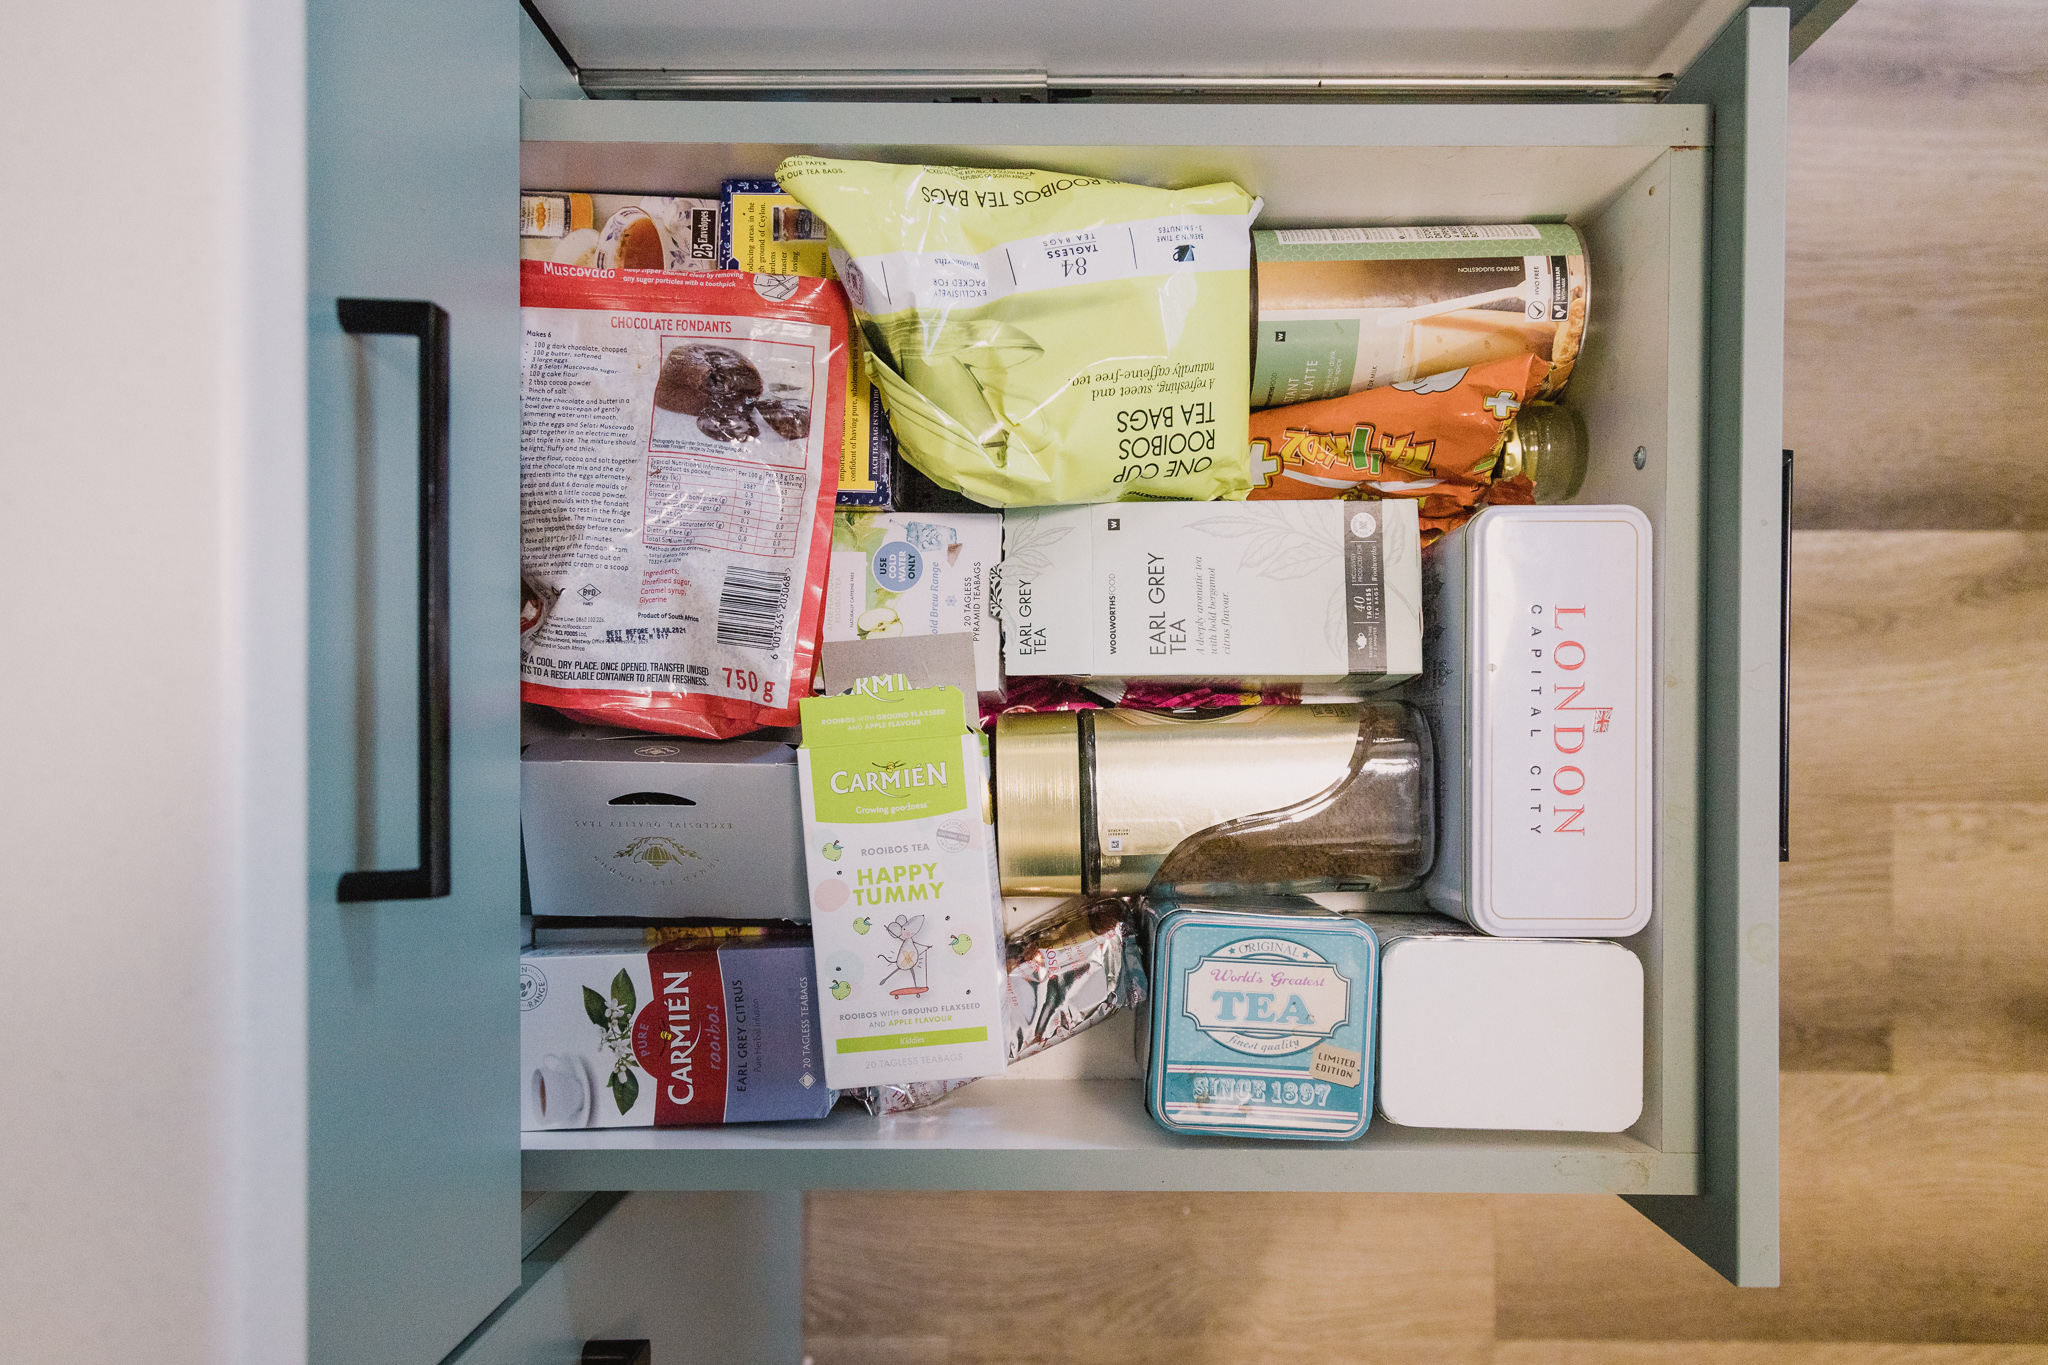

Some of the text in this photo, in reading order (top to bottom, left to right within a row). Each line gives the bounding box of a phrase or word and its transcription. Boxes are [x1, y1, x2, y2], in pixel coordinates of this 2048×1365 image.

[786, 169, 803, 180] OUR
[921, 176, 1102, 208] ROOIBOS TEA BAGS
[692, 210, 714, 258] 25 Envelopes
[747, 202, 755, 242] areas the
[758, 202, 767, 264] ground of Ceylon.
[1042, 232, 1096, 248] TEA BAGS
[1046, 243, 1099, 259] TAGLESS
[543, 261, 616, 279] Muscovado
[791, 251, 800, 273] loving
[1061, 257, 1088, 278] 84
[1495, 265, 1520, 273] SERVING
[705, 280, 736, 288] toothpick
[932, 278, 987, 288] PACKED FOR
[933, 288, 988, 298] EXCLUSIVELY
[610, 316, 732, 333] CHOCOLATE FONDANTS
[1095, 362, 1215, 384] naturally caffeine-free
[1304, 360, 1318, 391] LATTE
[1091, 378, 1207, 401] refreshing, sweet and
[849, 361, 859, 482] confident having pure, wholesome
[1116, 401, 1215, 433] TEA BAGS
[1118, 428, 1215, 460] ROOIBOS
[1112, 456, 1213, 484] ONE CUP
[879, 557, 888, 575] USE
[888, 553, 897, 579] COLD
[897, 550, 907, 582] WATER
[907, 553, 916, 580] ONLY
[640, 586, 688, 597] Caramel syrup,
[641, 578, 692, 588] Unrefined sugar,
[929, 561, 942, 616] Brew Range
[639, 596, 668, 605] Glycerine
[963, 576, 972, 627] 20 TAGLESS
[972, 561, 981, 642] PYRAMID TEABAGS
[1147, 552, 1167, 656] EARL GREY
[1194, 555, 1206, 645] deeply aromatic tea
[1208, 567, 1219, 655] with bold bergamot
[1353, 595, 1366, 613] 40
[668, 613, 684, 621] South
[684, 614, 700, 623] Africa
[1018, 578, 1032, 656] EARL GREY
[1033, 627, 1047, 656] TEA
[1169, 618, 1187, 656] TEA
[1221, 630, 1231, 655] citrus
[533, 666, 710, 687] TO A RESEALABLE CONTAINER TO RETAIN FRESHNESS.
[558, 660, 709, 676] DRY ONCE TRANSFER UNUSED
[721, 667, 776, 703] 750 g
[821, 708, 946, 726] ROOIBOS WITH GROUND FLAXSEED
[864, 721, 887, 730] APPLE
[888, 719, 922, 728] FLAVOUR
[1529, 604, 1543, 835] CAPITAL CITY
[1553, 604, 1588, 836] LONDON
[830, 761, 948, 795] CARMIÉN
[855, 803, 928, 815] Growing goodness
[574, 820, 733, 830] EXCLUSIVE QUALITY TEAS
[861, 843, 930, 857] ROOIBOS TEA
[857, 862, 938, 886] HAPPY
[852, 881, 945, 907] TUMMY
[1238, 941, 1300, 958] ORIGINAL
[1210, 968, 1326, 987] World's Greatest
[526, 981, 546, 1009] RANGE
[839, 1002, 981, 1021] ROOIBOS WITH GROUND FLAXSEED
[1210, 989, 1316, 1026] TEA
[800, 976, 812, 1069] 20 TAGLESS TEABAGS
[868, 1014, 953, 1029] AND APPLE FLAVOUR
[640, 1022, 650, 1058] PURE
[662, 970, 697, 1106] CARMIÉN
[708, 1003, 720, 1071] rooibos
[731, 978, 748, 1093] EARL GREY CITRUS
[752, 997, 763, 1073] Pure Herbal Infusion
[899, 1035, 925, 1045] Kiddies
[1225, 1035, 1300, 1053] finest quality
[865, 1053, 964, 1070] 20 TAGLESS TEABAGS
[1315, 1063, 1354, 1080] EDITION
[1317, 1052, 1356, 1069] LIMITED
[1193, 1076, 1332, 1107] SINCE 1897
